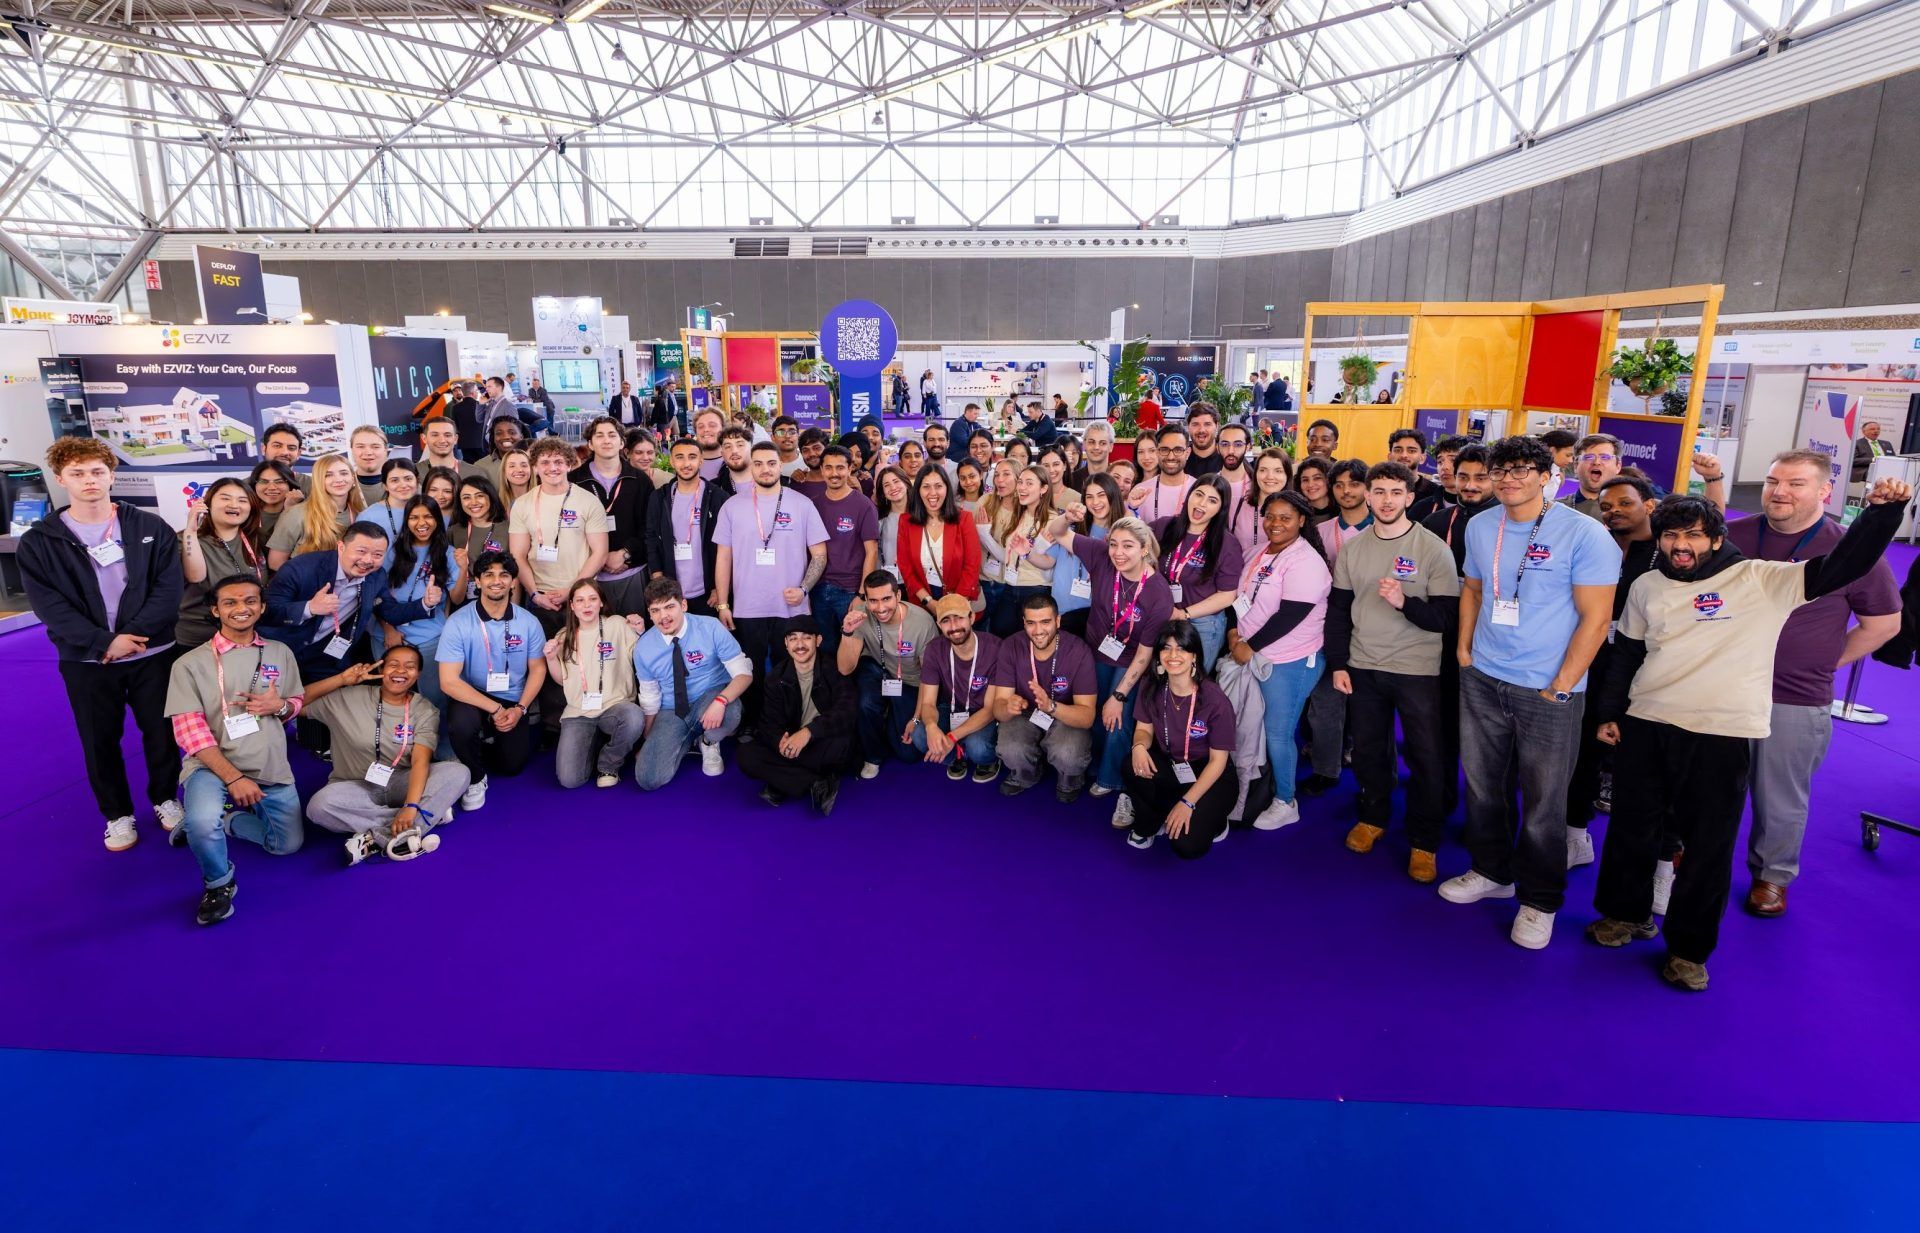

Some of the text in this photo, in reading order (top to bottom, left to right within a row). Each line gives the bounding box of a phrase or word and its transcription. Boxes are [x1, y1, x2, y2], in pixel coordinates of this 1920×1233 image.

[211, 262, 236, 271] DEPLOY
[213, 274, 241, 287] FAST
[183, 333, 231, 344] EZVIZ
[659, 348, 682, 357] simple
[661, 355, 682, 364] green
[116, 363, 297, 375] Easy with EZVIZ: Your Care, Our Focus
[794, 411, 820, 420] Recharge
[1426, 416, 1447, 429] Connect
